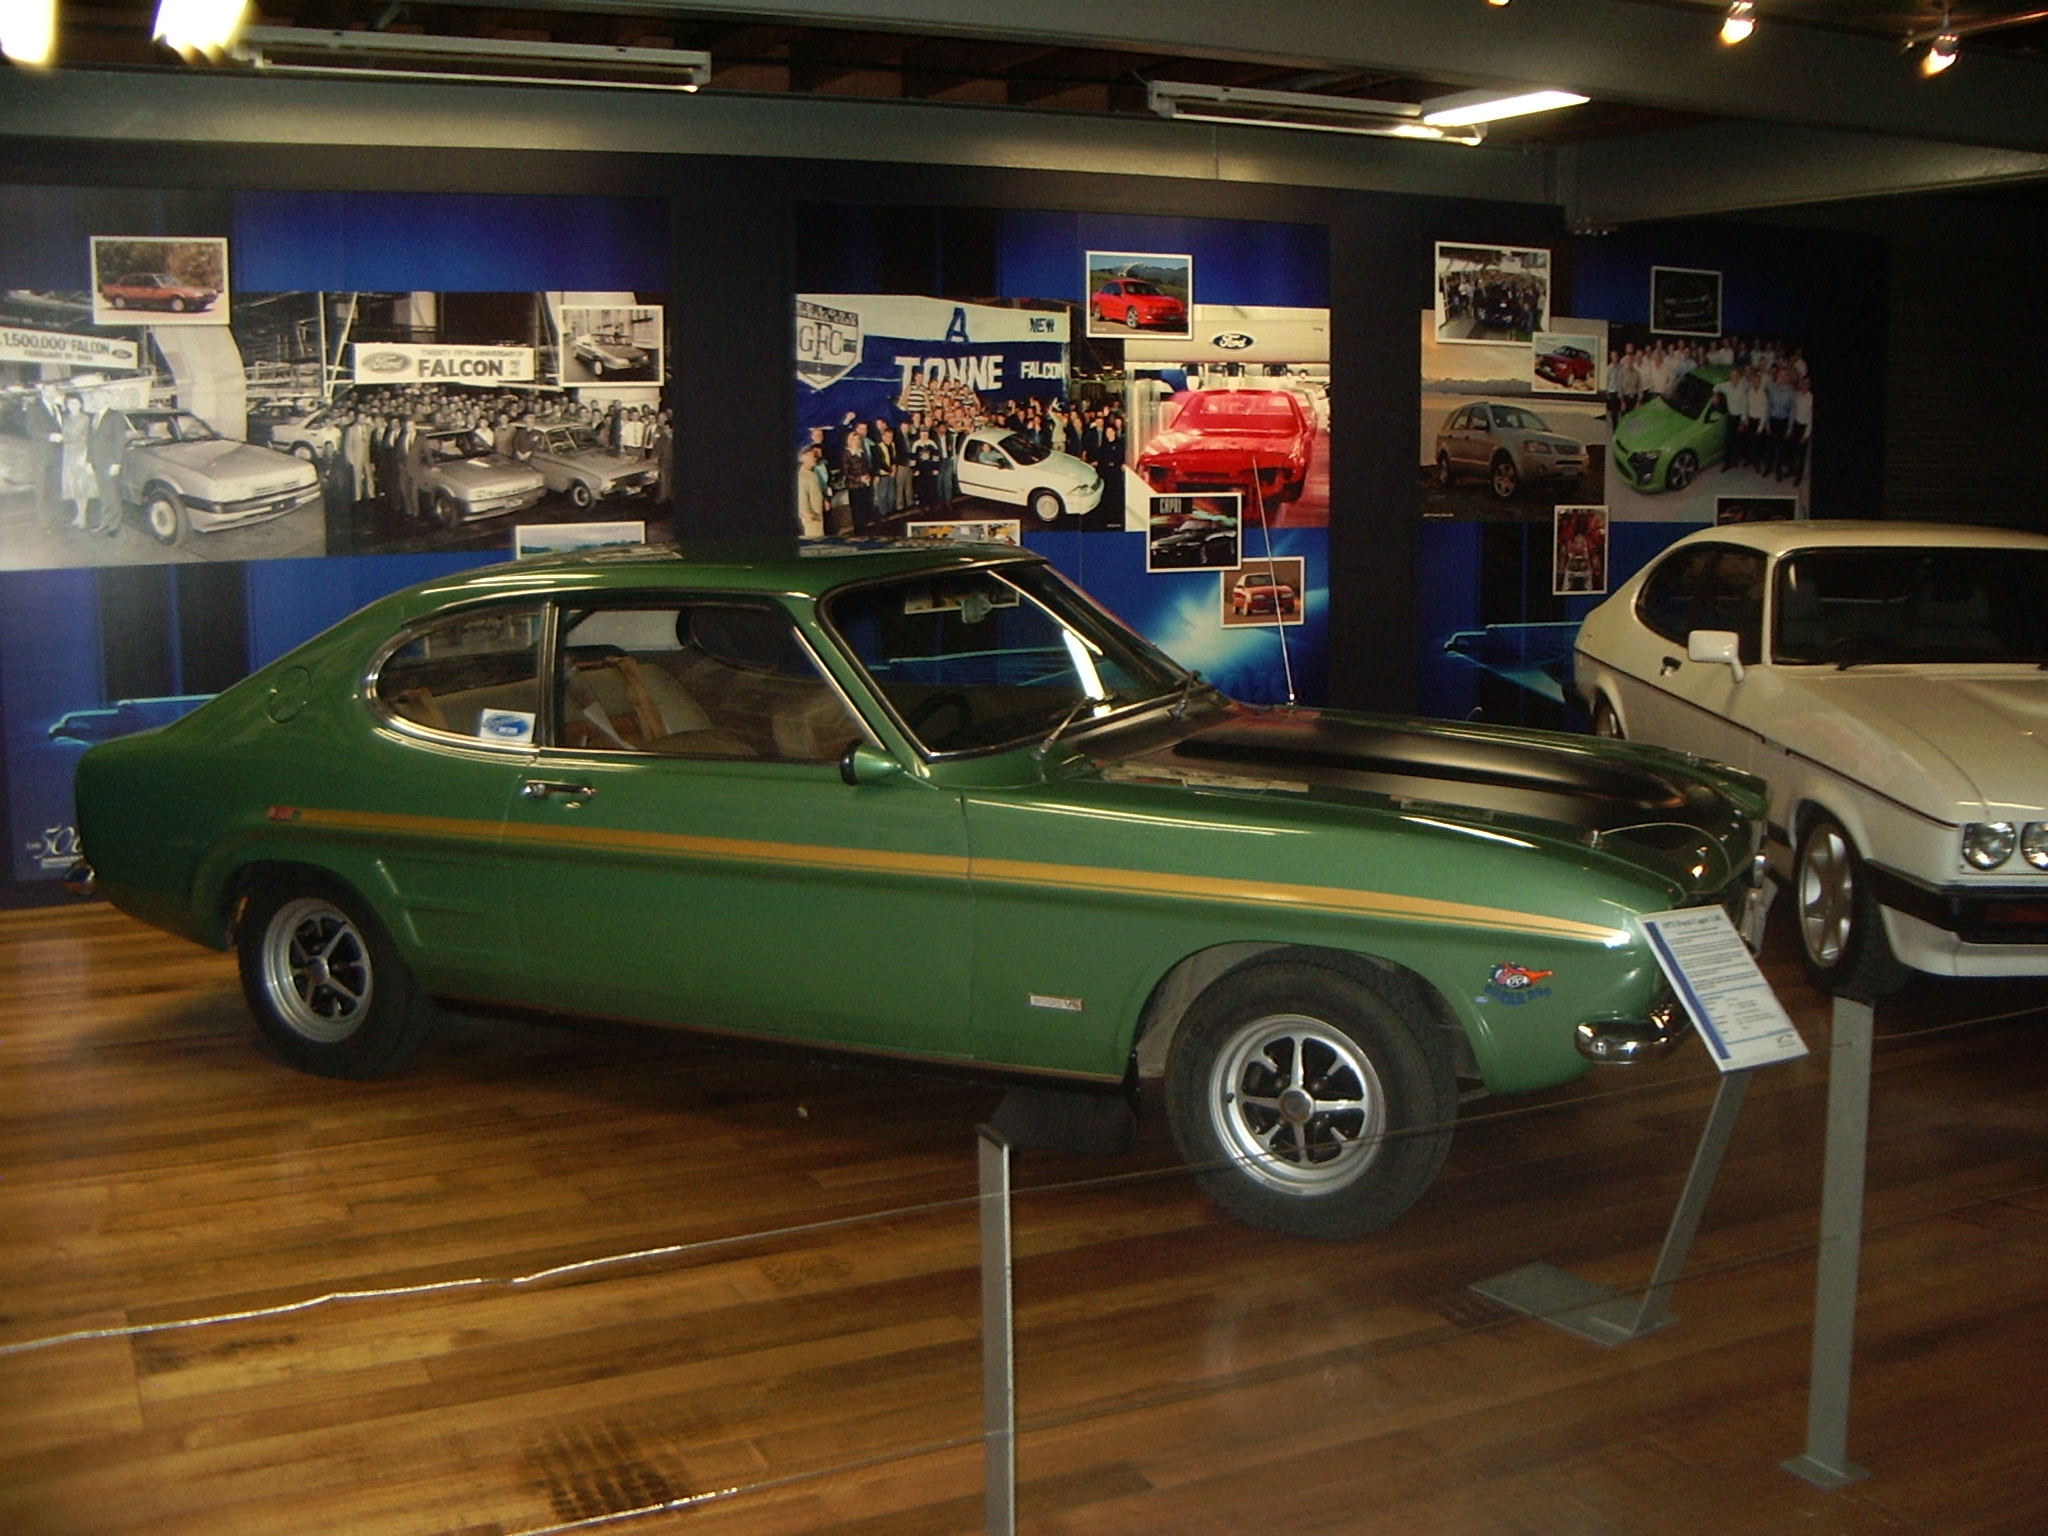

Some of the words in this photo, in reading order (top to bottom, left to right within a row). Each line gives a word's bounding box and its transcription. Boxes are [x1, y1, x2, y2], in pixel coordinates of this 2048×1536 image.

[945, 307, 970, 342] A
[1030, 317, 1055, 333] NEW
[71, 340, 110, 355] FALCON
[1219, 333, 1248, 348] Ford
[418, 359, 503, 377] FALCON
[894, 355, 1004, 393] TONNE
